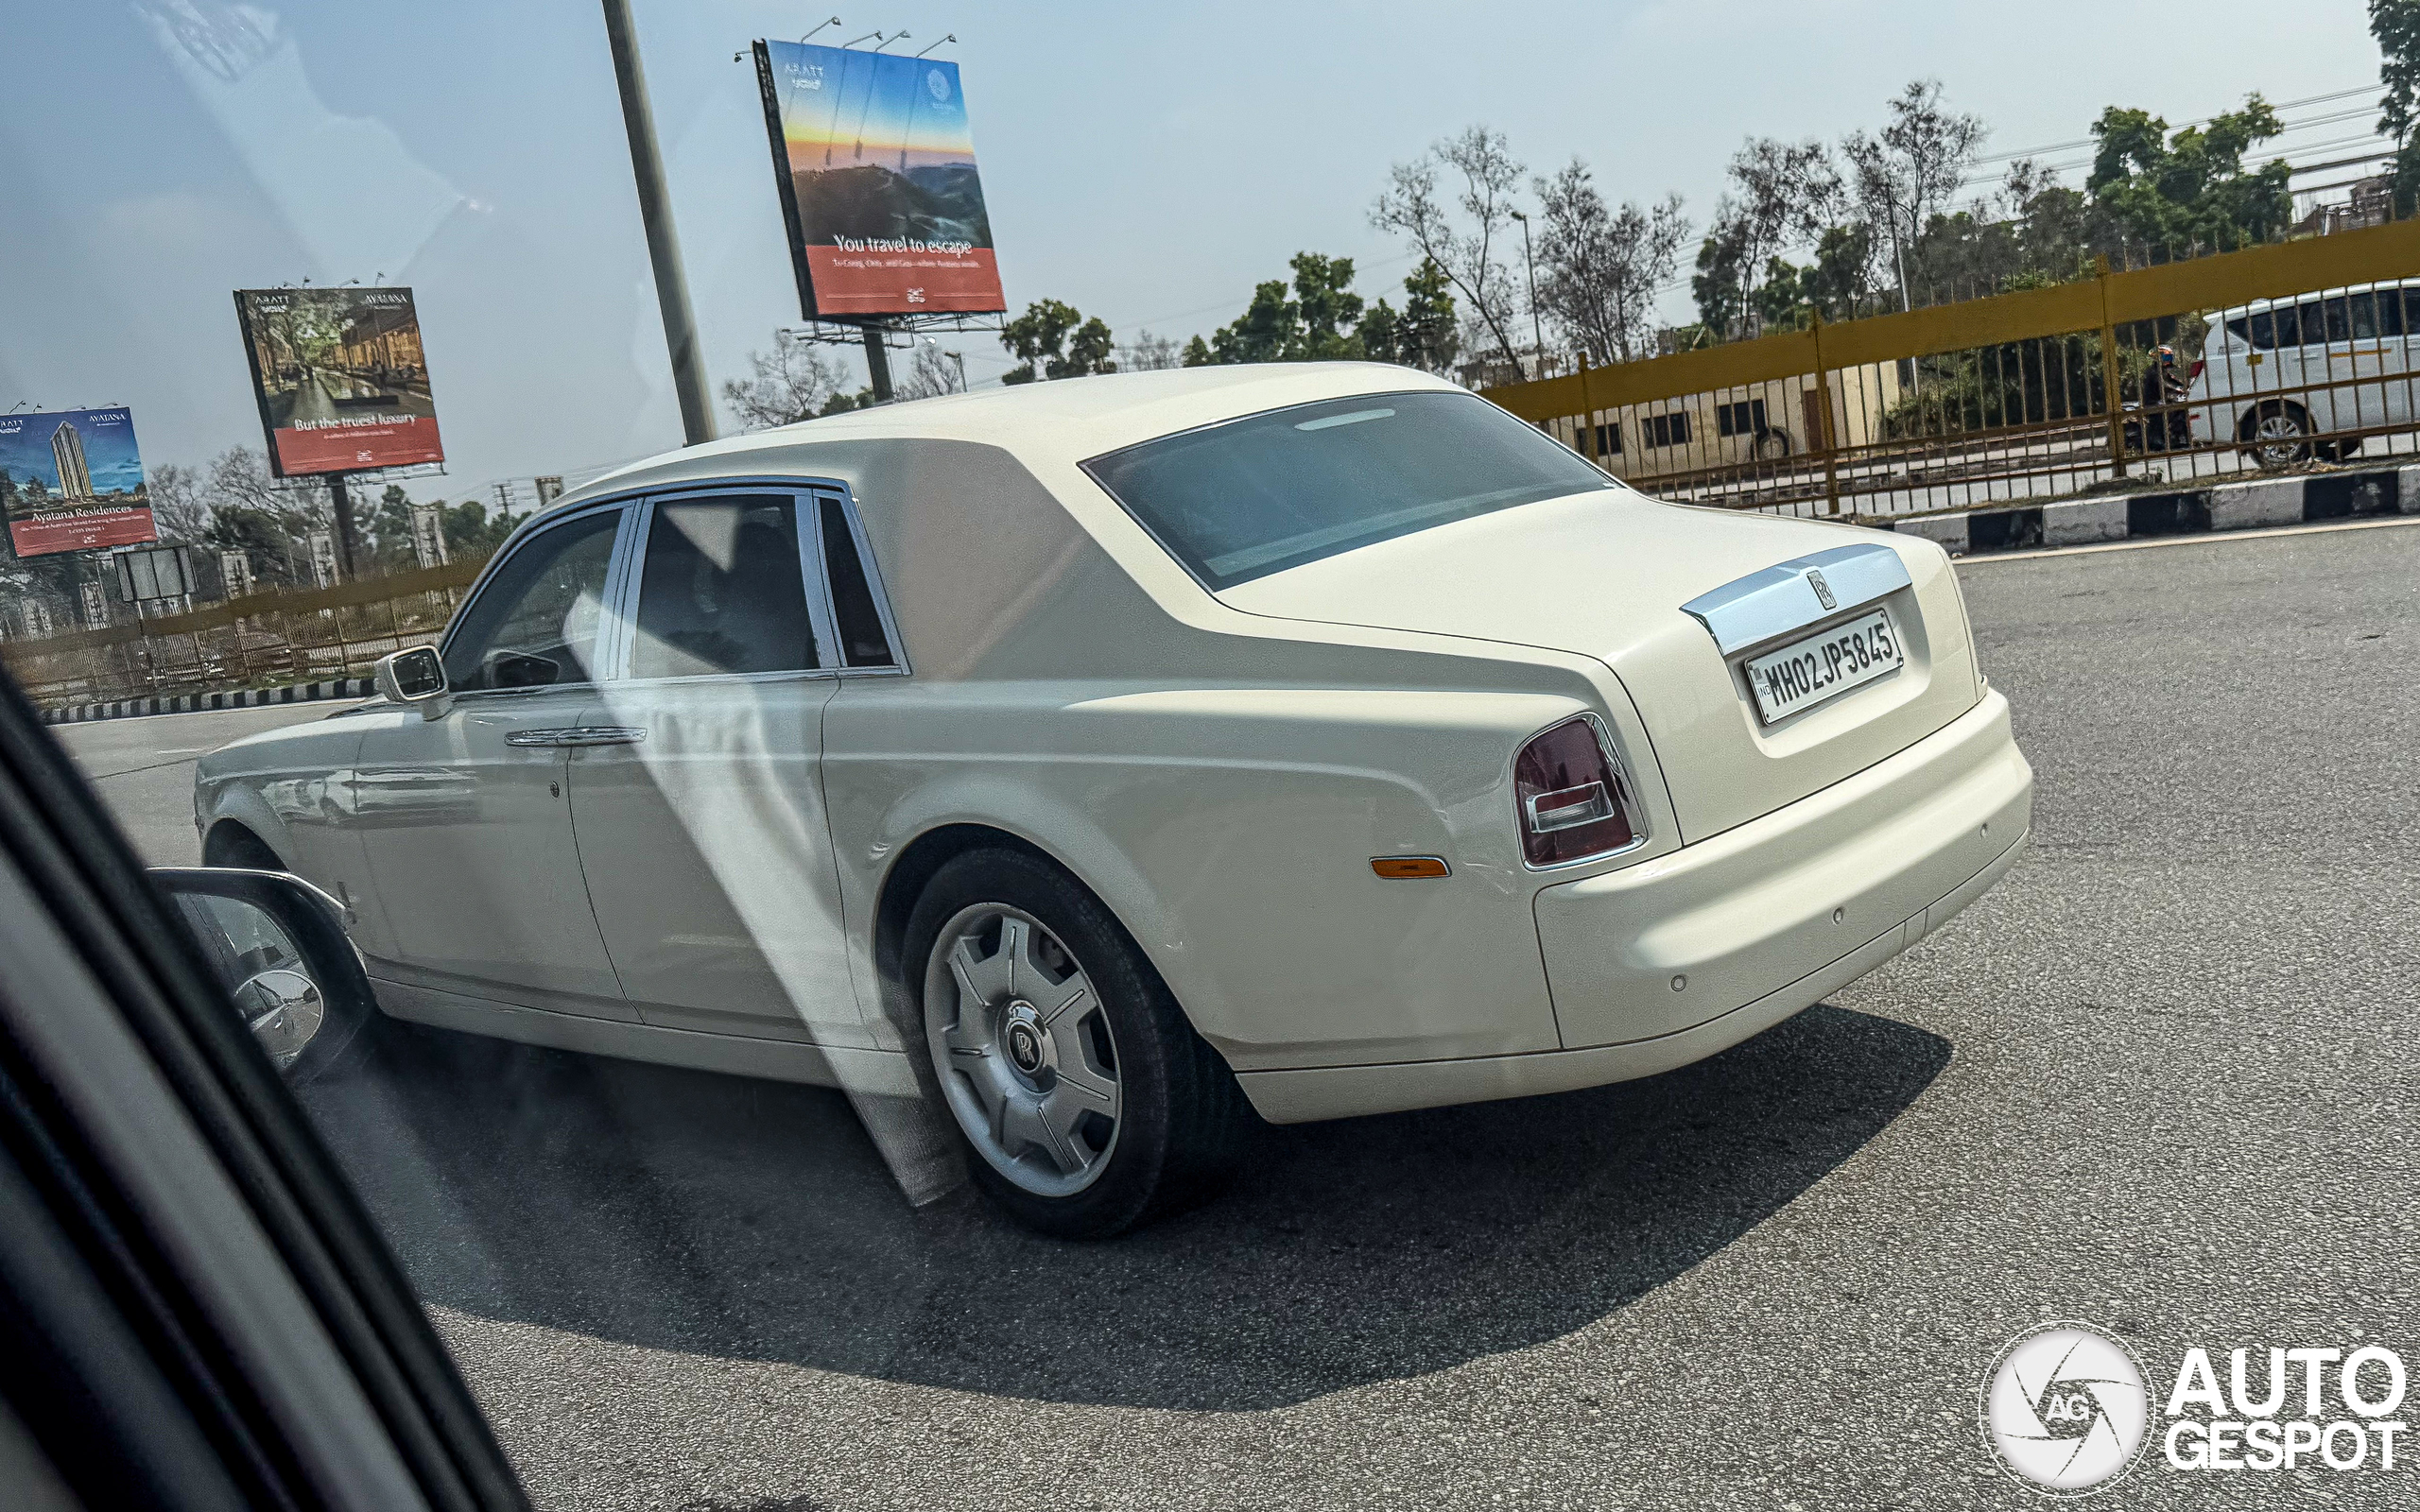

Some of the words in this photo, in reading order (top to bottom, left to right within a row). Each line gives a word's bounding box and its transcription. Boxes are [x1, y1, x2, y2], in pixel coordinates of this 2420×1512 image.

[833, 233, 865, 253] You
[866, 235, 908, 253] travel
[908, 237, 925, 253] to
[926, 238, 973, 259] escape
[294, 418, 318, 432] But
[320, 416, 339, 430] the
[341, 414, 376, 428] truest
[378, 413, 416, 426] luxury
[32, 509, 75, 524] Ayatana
[76, 506, 132, 519] Residences
[1764, 623, 1893, 707] MH02JP5845
[1757, 685, 1772, 698] IND
